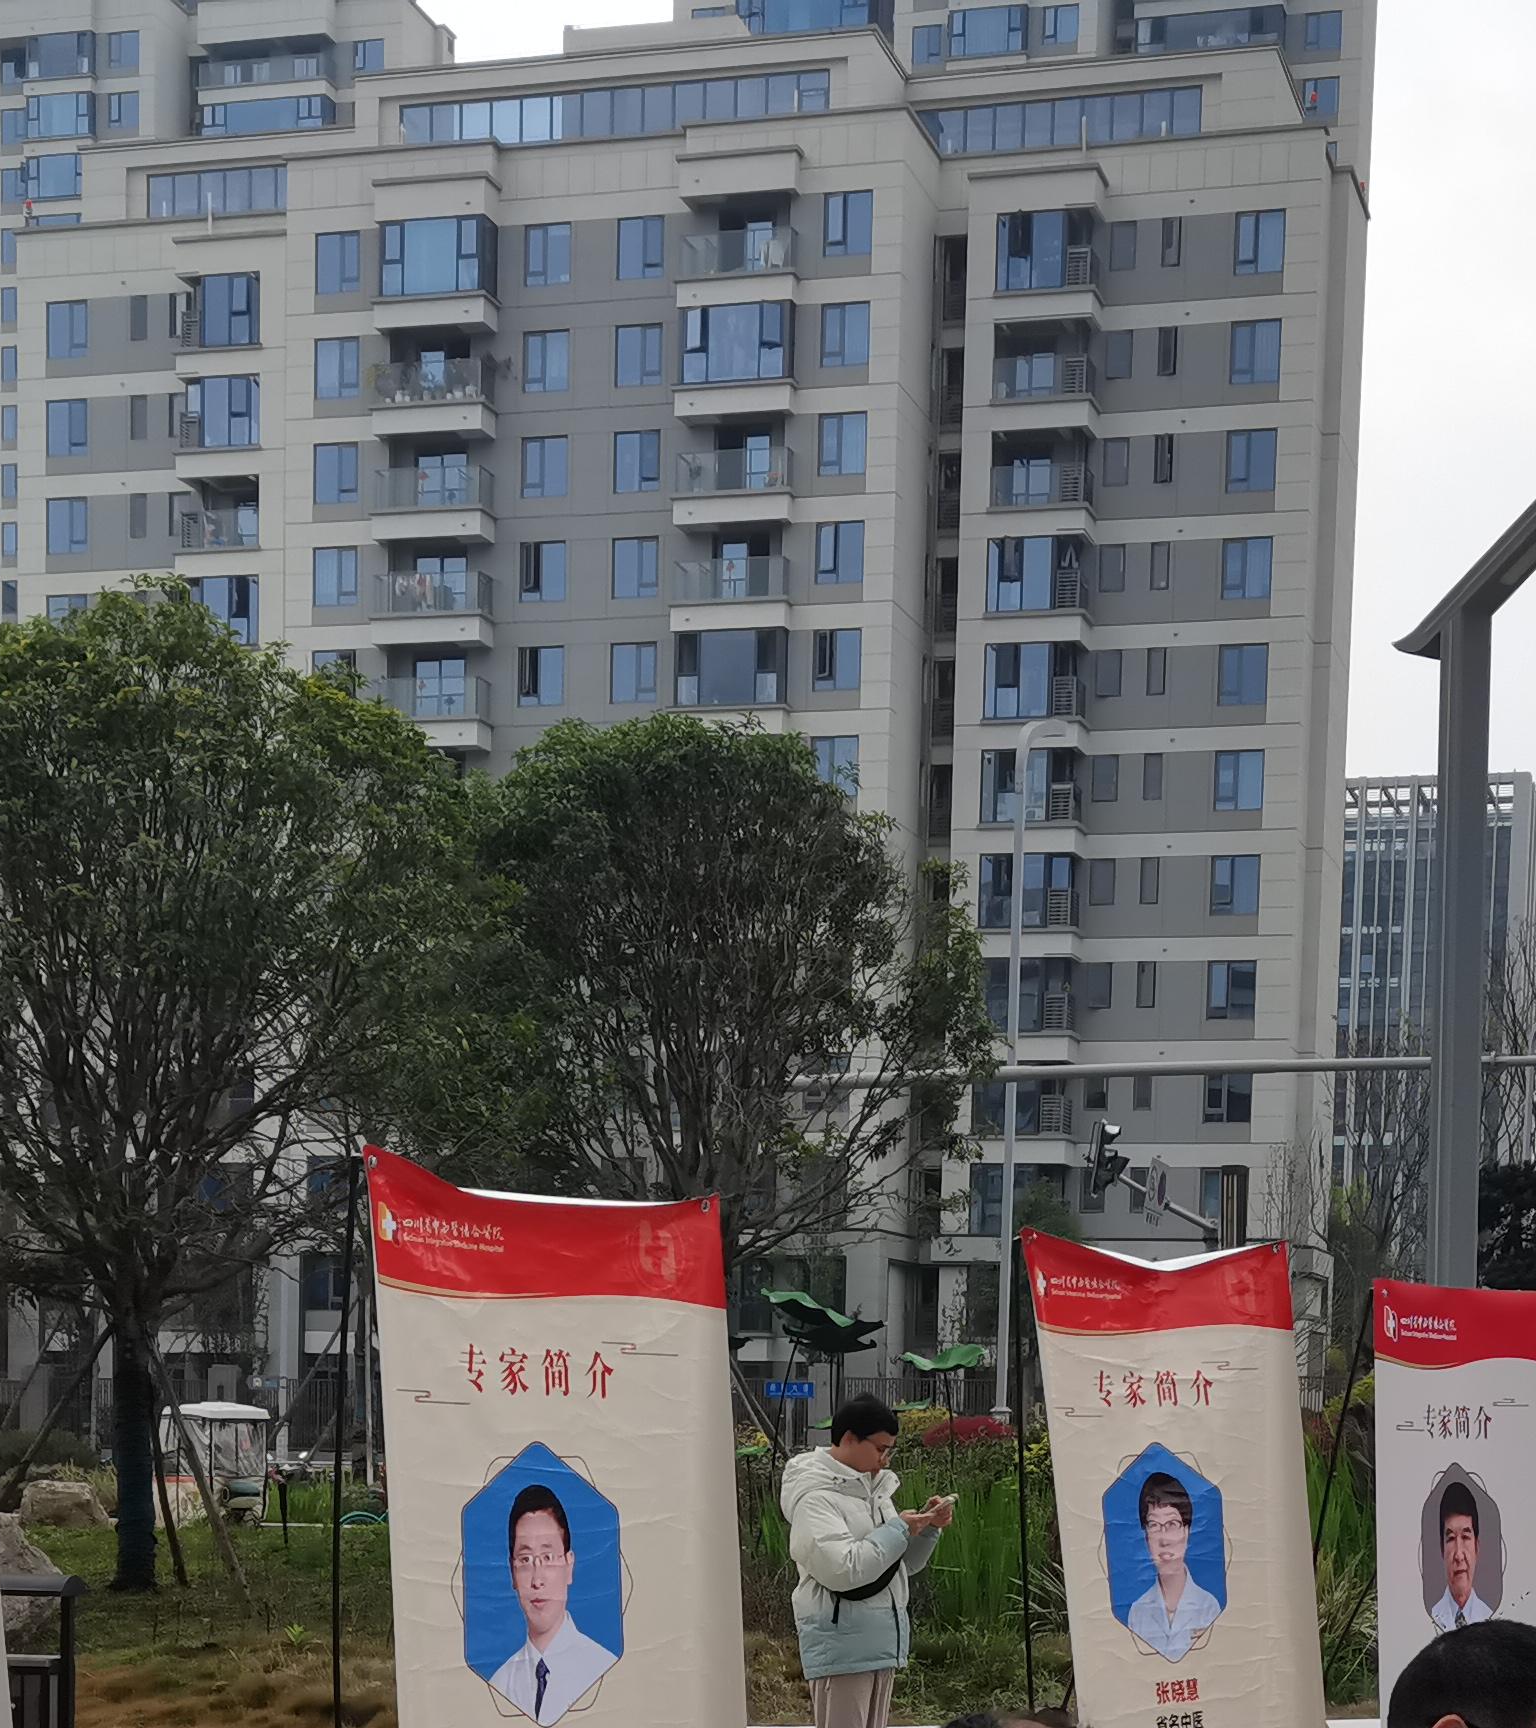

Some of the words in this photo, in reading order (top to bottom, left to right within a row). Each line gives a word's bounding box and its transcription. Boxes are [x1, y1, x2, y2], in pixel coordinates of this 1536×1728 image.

[459, 1343, 614, 1399] 专家简介
[1094, 1370, 1214, 1408] 专家简介
[1424, 1404, 1492, 1440] 专家简介
[1156, 1678, 1200, 1705] 张晓慧
